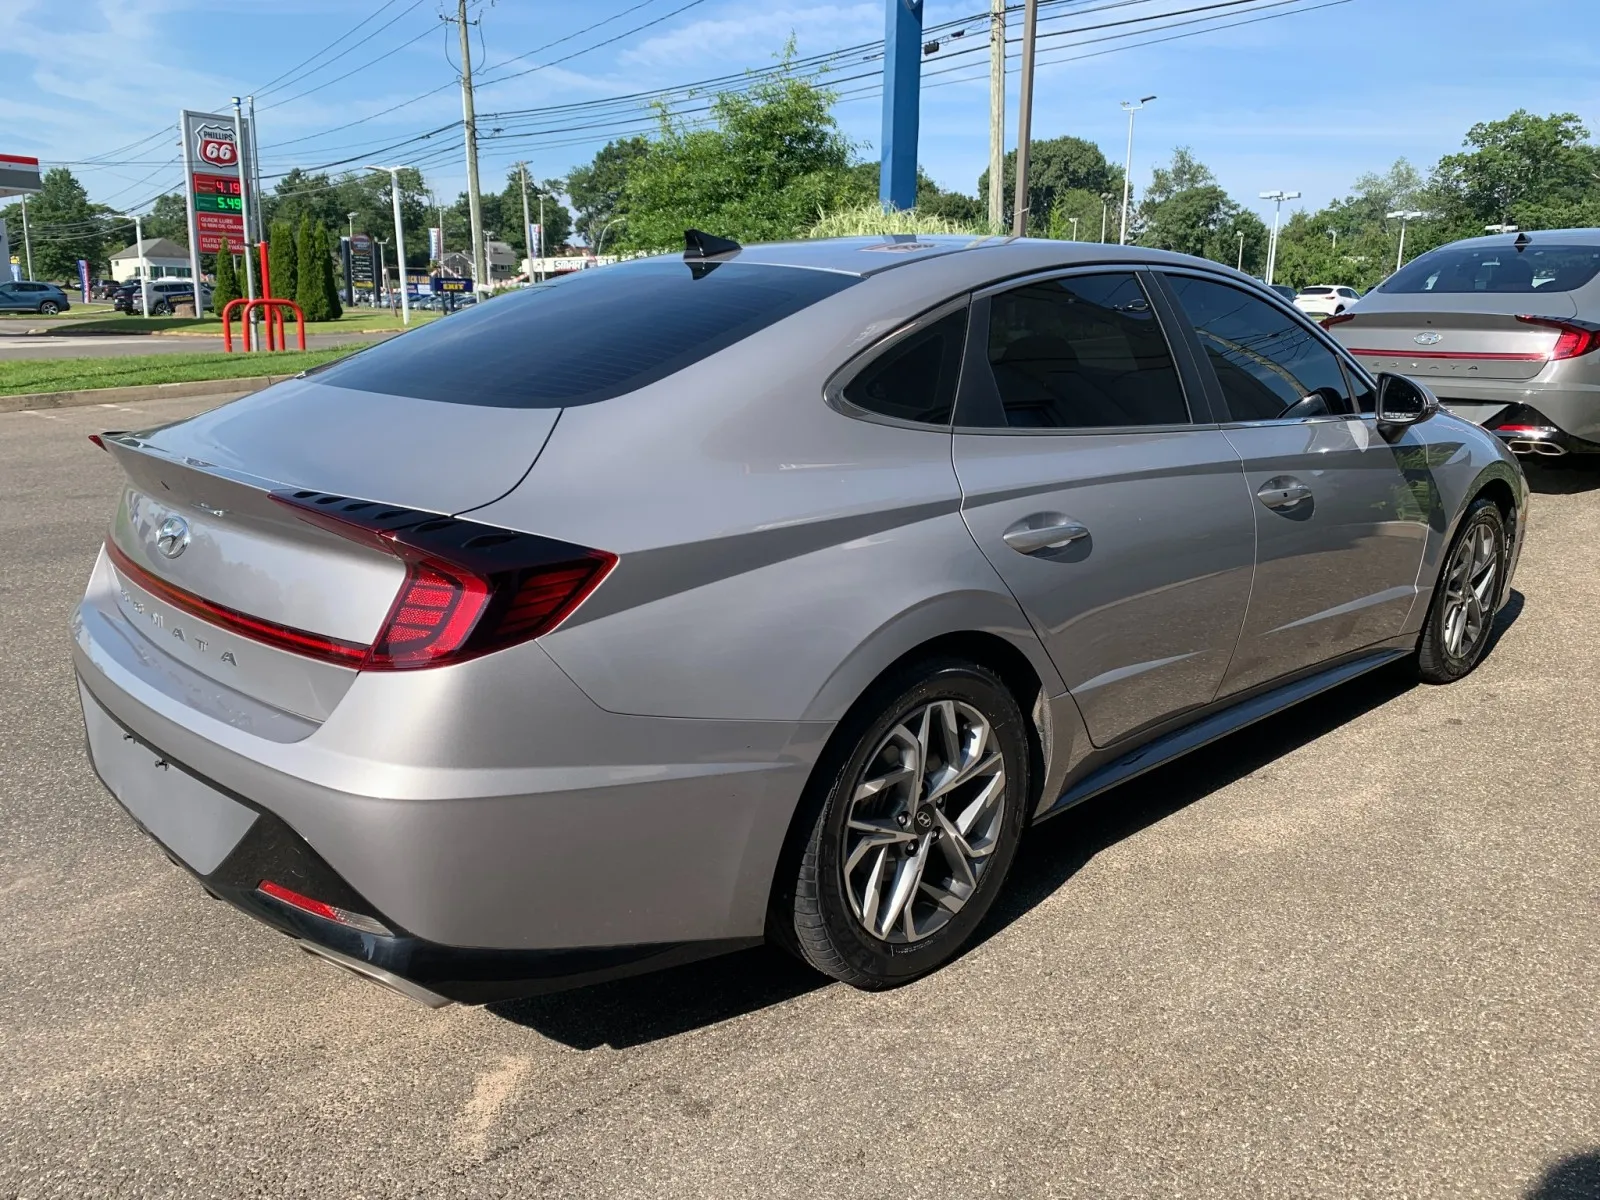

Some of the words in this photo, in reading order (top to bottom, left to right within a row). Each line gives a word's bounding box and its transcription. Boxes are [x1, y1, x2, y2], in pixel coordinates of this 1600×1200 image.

[204, 130, 233, 141] PHILLIPS
[206, 143, 231, 160] 66
[216, 181, 240, 194] 4.19
[217, 197, 242, 210] 5.49
[555, 260, 586, 271] SMART
